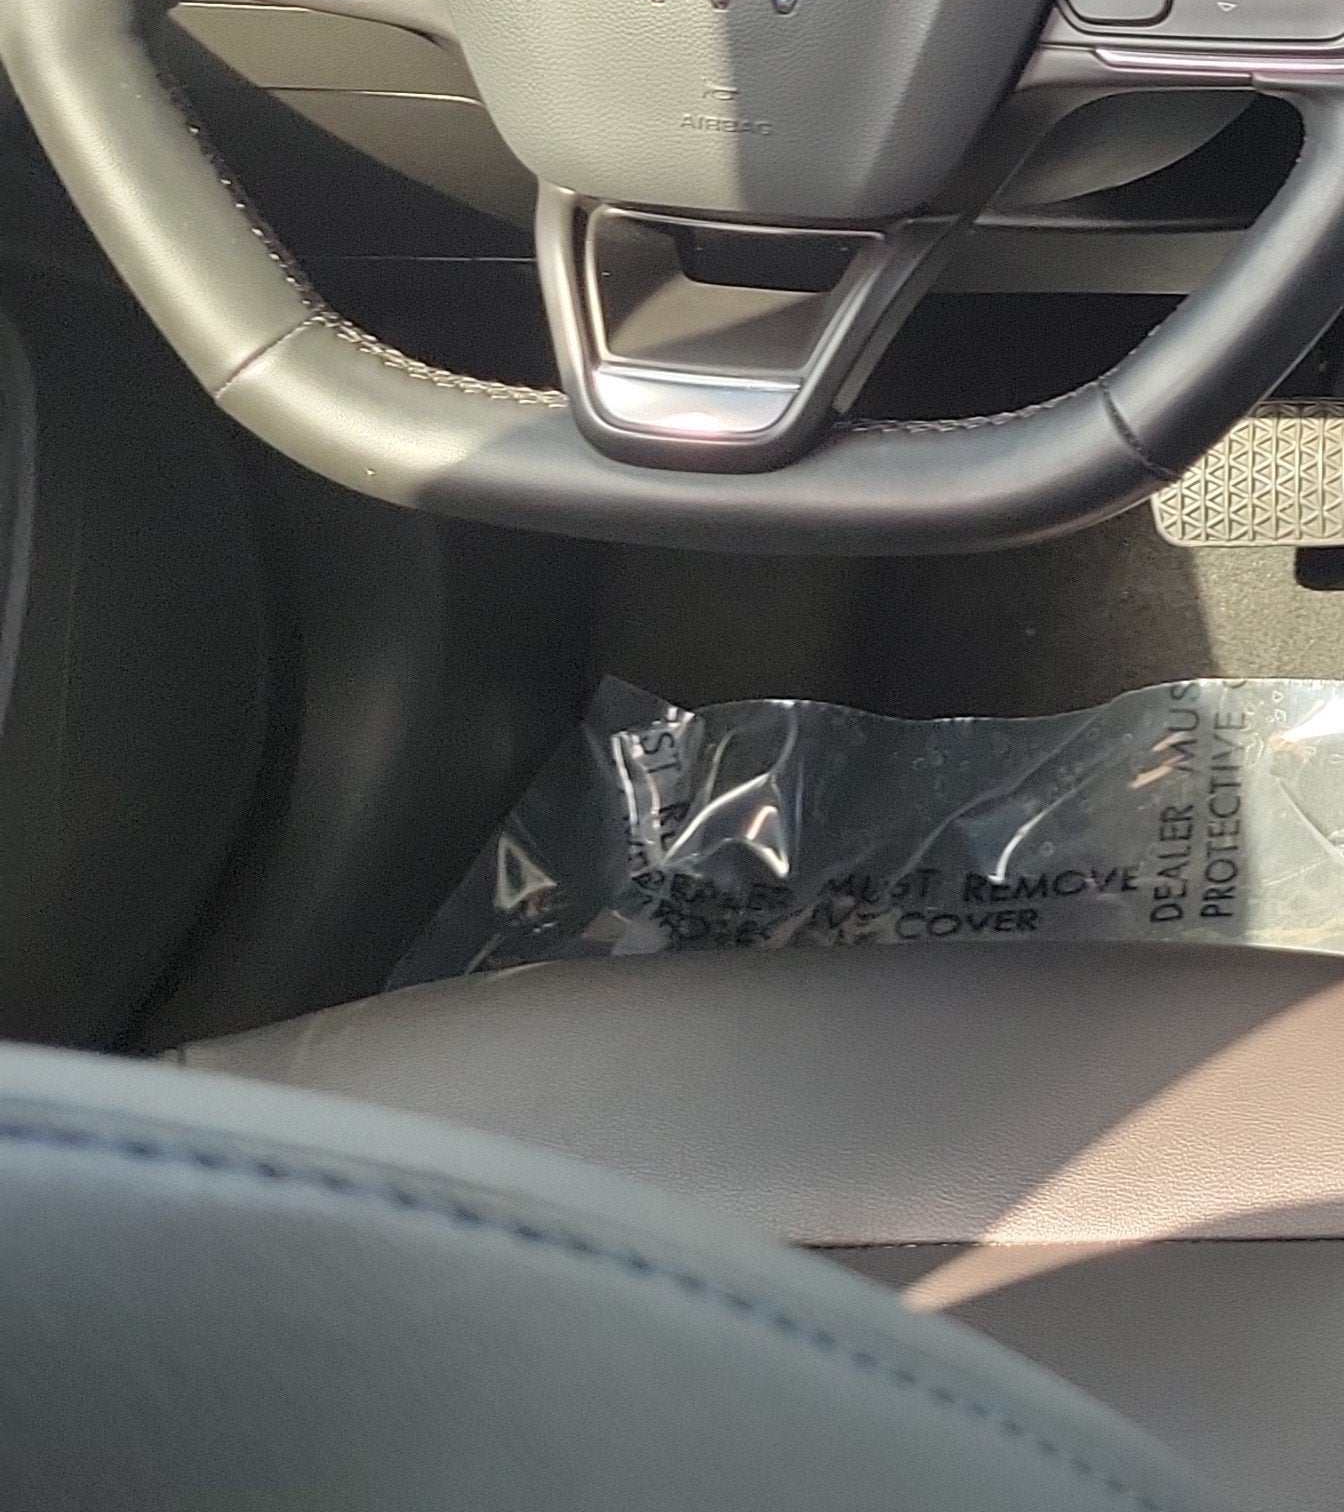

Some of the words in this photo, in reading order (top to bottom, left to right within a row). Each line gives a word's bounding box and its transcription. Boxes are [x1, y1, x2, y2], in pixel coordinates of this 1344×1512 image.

[680, 113, 772, 137] AIRBAG
[1199, 711, 1247, 920] PROTECTIVE
[1150, 803, 1194, 923] DEALER
[963, 865, 1138, 903] REMOVE
[895, 909, 1039, 941] COVER
